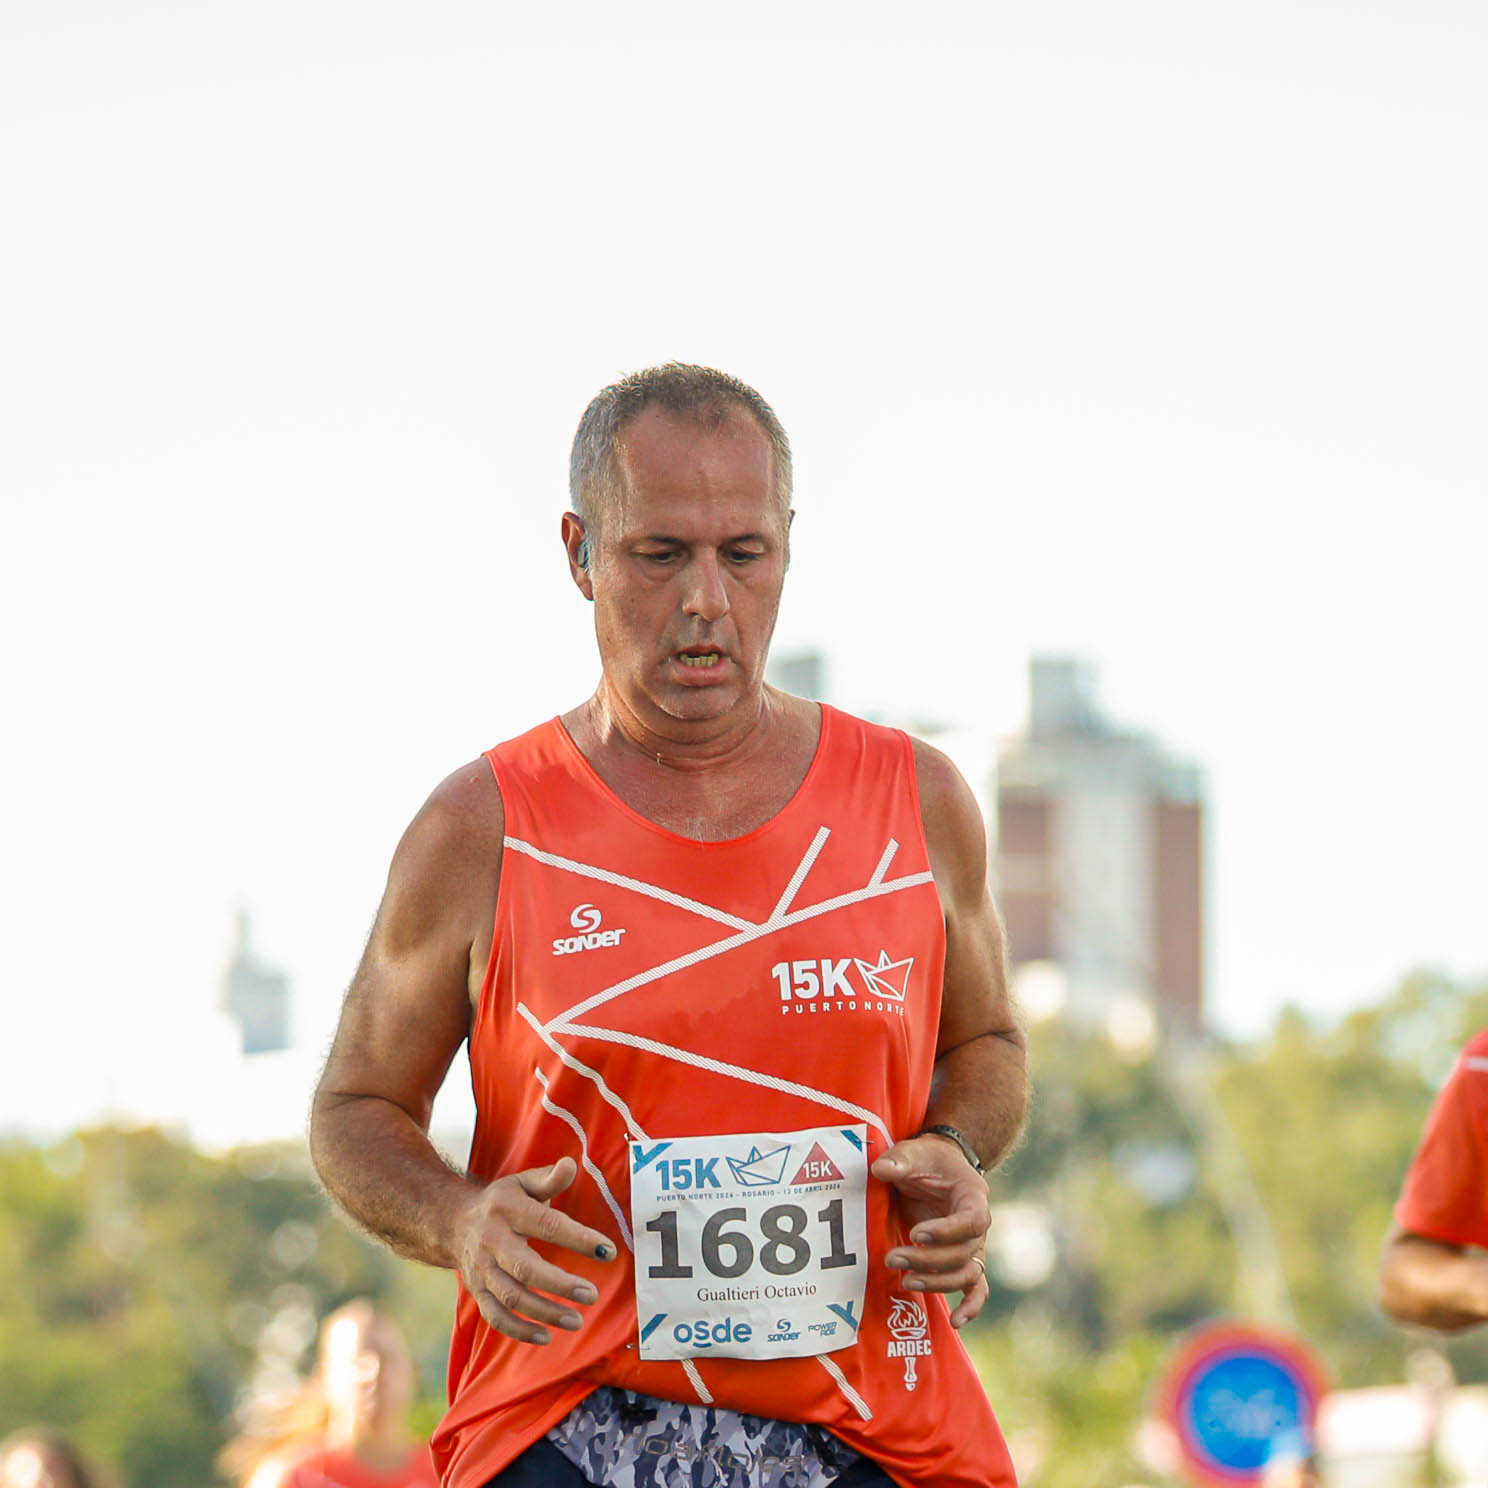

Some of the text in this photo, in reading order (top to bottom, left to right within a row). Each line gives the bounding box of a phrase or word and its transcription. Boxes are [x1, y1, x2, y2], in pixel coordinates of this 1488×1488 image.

[771, 958, 856, 1001] 15K
[781, 1000, 905, 1016] PUERTO NORTE
[655, 1157, 722, 1190] 15K
[802, 1160, 833, 1179] 15K
[655, 1193, 686, 1202] PUERTO
[688, 1192, 713, 1201] NORTE
[742, 1189, 775, 1198] ROSARIO
[645, 1198, 857, 1279] 1681
[696, 1281, 817, 1302] Gualtieri Octavio
[673, 1316, 753, 1346] osde
[887, 1340, 932, 1357] ARDEC
